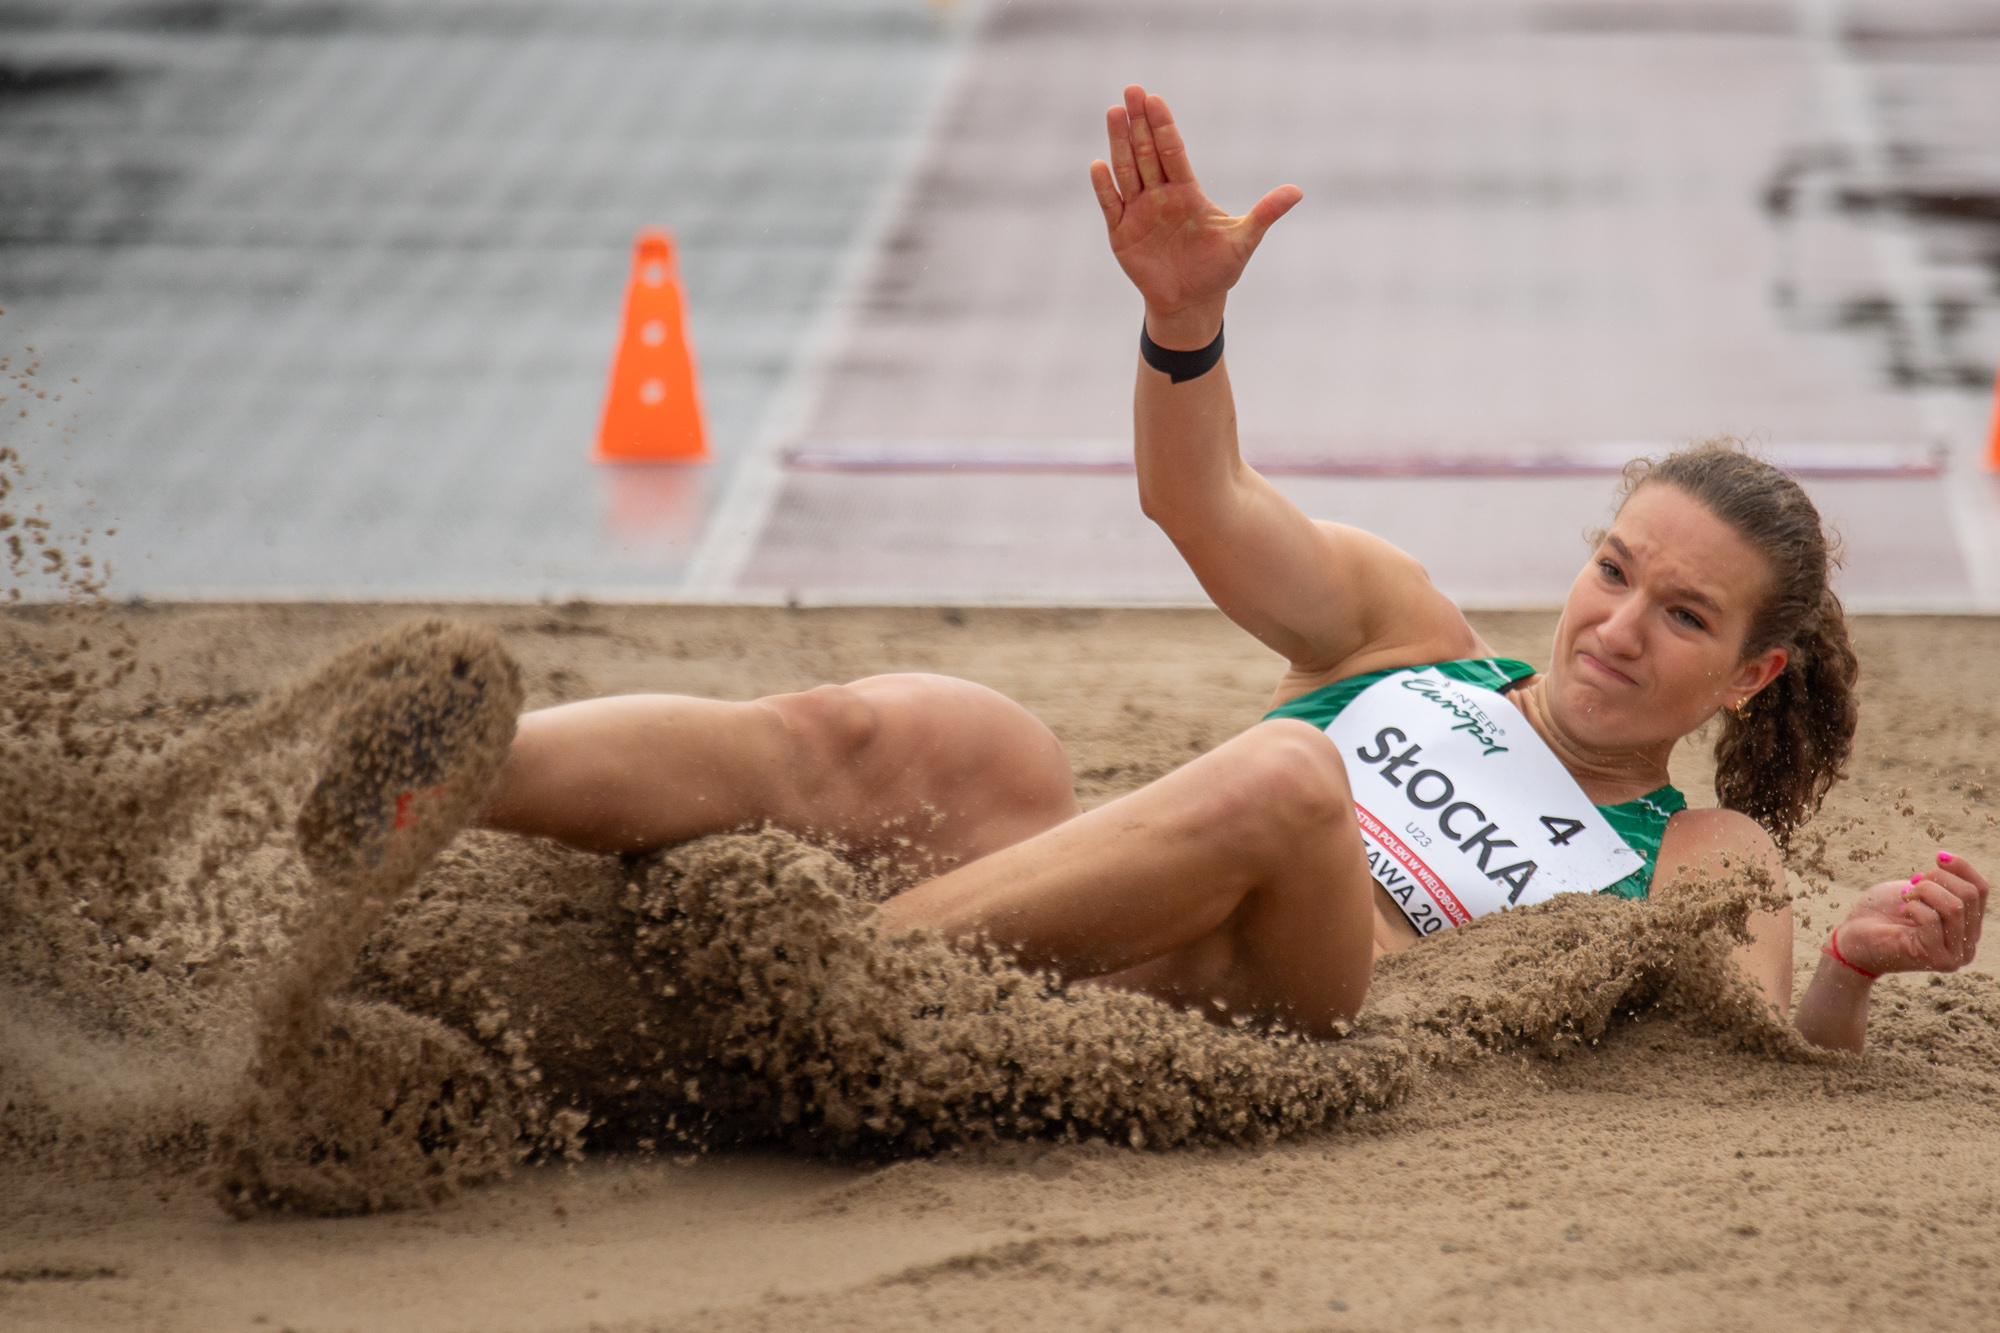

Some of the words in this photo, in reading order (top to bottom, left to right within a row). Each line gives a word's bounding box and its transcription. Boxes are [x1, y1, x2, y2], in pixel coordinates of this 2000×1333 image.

[1401, 679, 1509, 756] Europol
[1354, 807, 1382, 836] STWA
[1378, 831, 1411, 862] POLSKI
[1408, 858, 1422, 871] W
[1356, 726, 1539, 906] SŁOCKA
[1405, 822, 1433, 848] U23
[1539, 815, 1586, 848] 4
